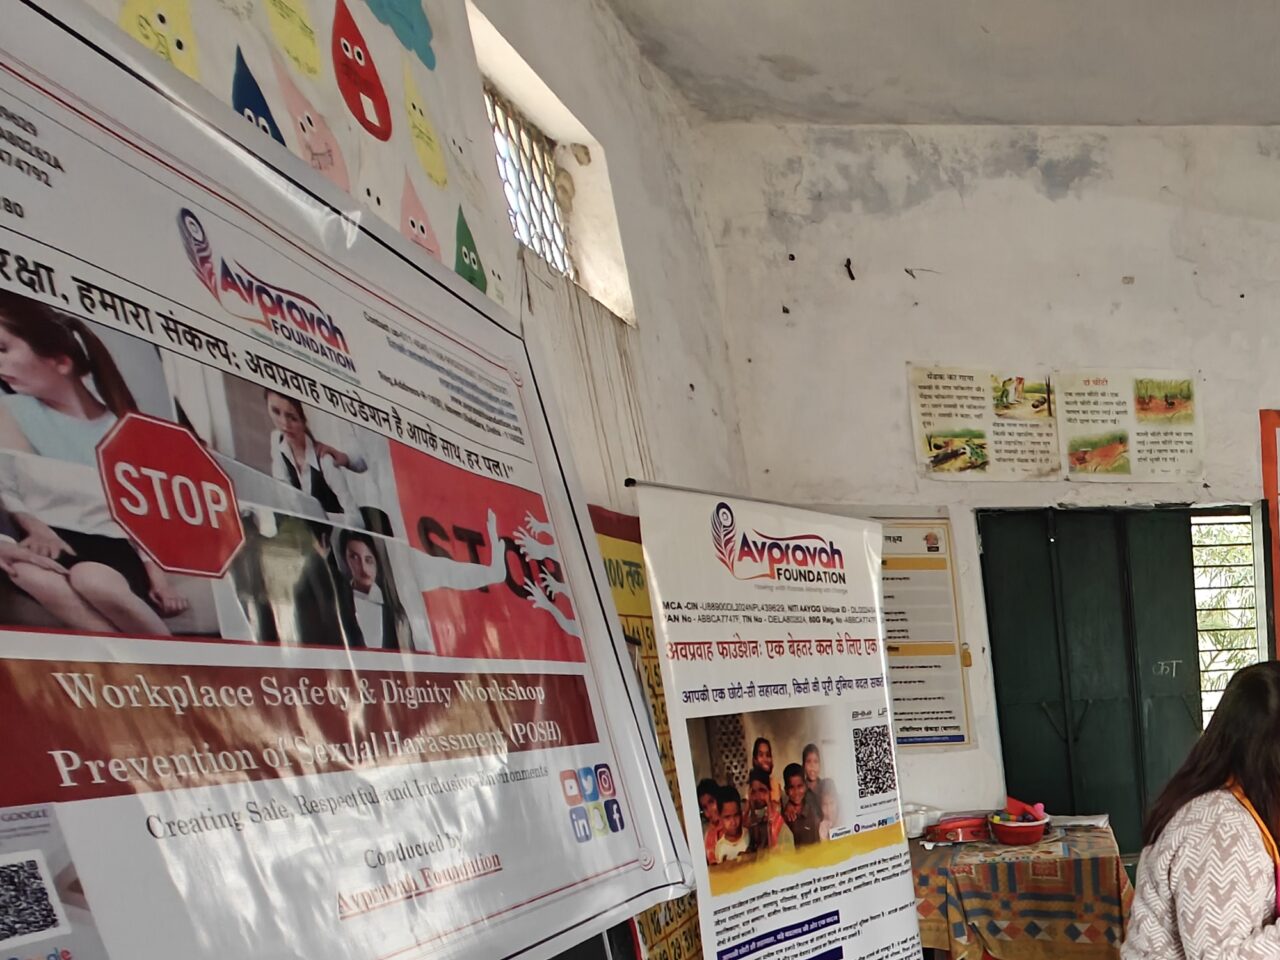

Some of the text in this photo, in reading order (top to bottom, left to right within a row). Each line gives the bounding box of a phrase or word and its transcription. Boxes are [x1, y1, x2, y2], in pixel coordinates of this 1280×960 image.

[220, 256, 350, 355] Avpravah
[271, 318, 357, 373] FOUNDATION
[71, 275, 154, 334] हमारा
[245, 351, 321, 403] अवप्रवाह
[321, 381, 393, 433] फाउंडेशन
[391, 406, 404, 439] है
[406, 421, 439, 452] आपके
[440, 436, 466, 466] साथ,
[464, 449, 483, 471] हर
[113, 461, 229, 530] STOP
[737, 531, 845, 579] Avpravah
[776, 567, 847, 585] FOUNDATION
[663, 601, 683, 611] MCA
[666, 641, 712, 661] अवप्रवाह
[765, 640, 784, 659] एक
[787, 632, 812, 658] बेहतर
[815, 638, 833, 657] कल
[836, 632, 845, 657] के
[845, 632, 863, 656] लिए
[864, 638, 878, 656] एक
[51, 671, 545, 715] Workplace Safety & Dignity Workshop
[682, 684, 710, 704] आपकी
[712, 688, 726, 703] एक
[792, 677, 810, 695] किसी
[48, 721, 562, 788] Prevention of Sexual Harassment (POSH)
[146, 806, 243, 840] Creating
[246, 801, 294, 825] Safe,
[384, 786, 412, 806] and
[414, 773, 476, 799] Inclusive
[478, 764, 549, 788] Environments
[364, 832, 465, 869] Conducted by
